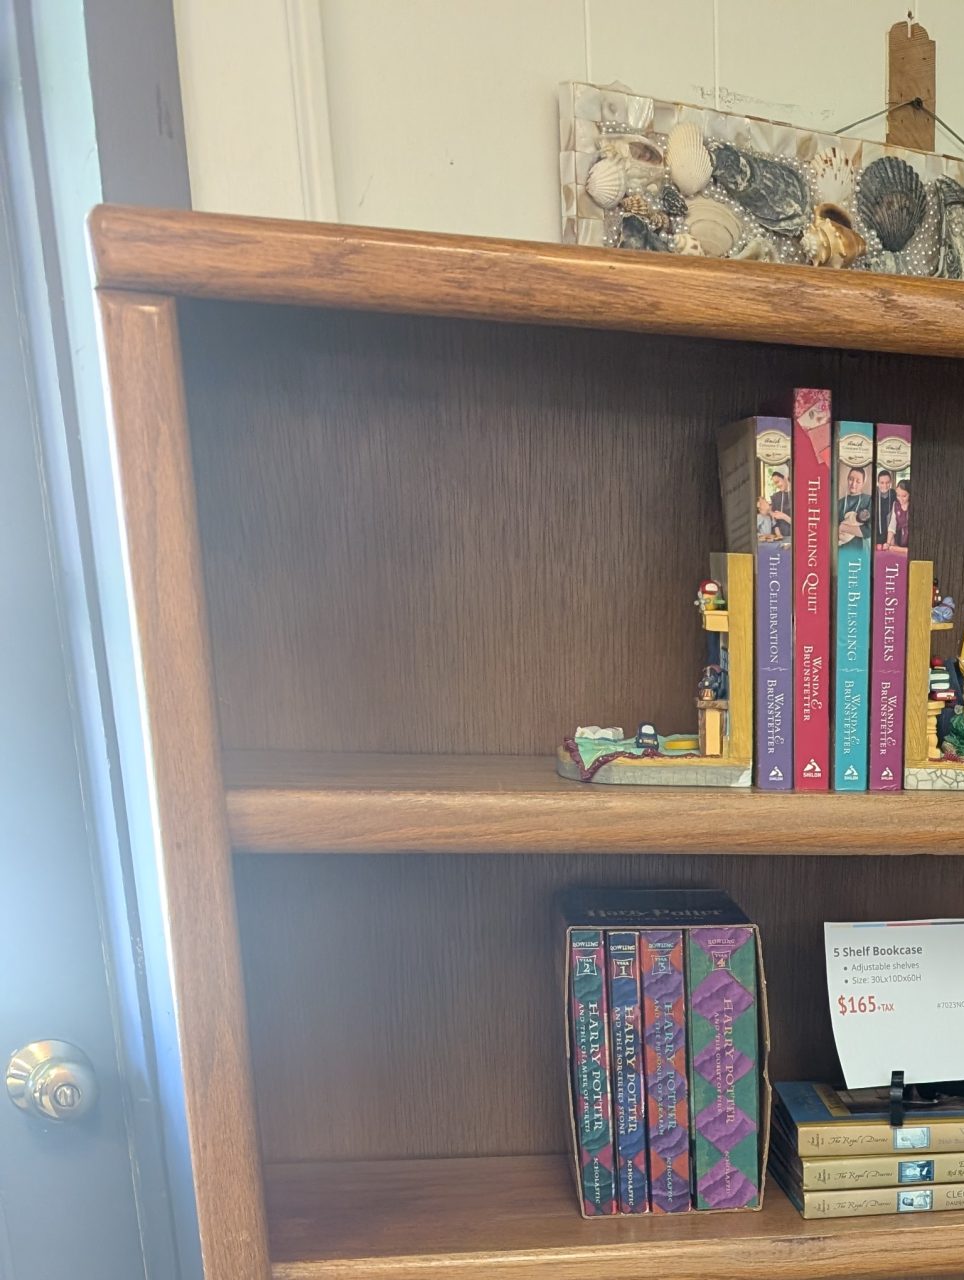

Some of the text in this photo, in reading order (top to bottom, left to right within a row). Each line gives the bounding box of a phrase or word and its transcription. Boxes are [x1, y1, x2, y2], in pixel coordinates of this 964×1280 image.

[802, 476, 821, 614] THE HEALING QUILT
[769, 553, 781, 664] THE CELEBRATION
[848, 558, 862, 661] THE BLESSING
[884, 563, 899, 662] THE SEEKERS
[803, 646, 814, 721] BRUNSTETTER
[812, 656, 822, 697] WANDA
[767, 680, 777, 754] BRUNSTETTER
[774, 693, 784, 733] WANDA
[844, 680, 854, 754] BRUNSTETTER
[850, 694, 861, 734] WANDA
[880, 681, 891, 756] BRUNSTETTER
[886, 695, 897, 734] WANDA
[583, 963, 590, 973] 2
[620, 966, 626, 975] 1
[658, 962, 666, 972] 3
[716, 958, 726, 968] 4
[833, 945, 923, 958] 5 Shelf Bookcase
[852, 962, 920, 973] Adjustable shelves
[852, 976, 870, 984] Size:
[614, 1006, 622, 1028] AND
[588, 1002, 602, 1131] HARRY POTTER
[624, 1005, 638, 1133] HARRY POTTER
[664, 1001, 676, 1130] HARRY POTTER
[724, 998, 735, 1124] HARRY POTTER
[584, 1089, 588, 1100] OF
[716, 1082, 722, 1094] OF
[828, 1136, 841, 1145] The
[842, 1136, 862, 1146] Royal
[834, 1171, 848, 1180] The
[848, 1170, 868, 1182] Royal
[833, 1201, 846, 1210] The
[847, 1200, 866, 1212] Royal
